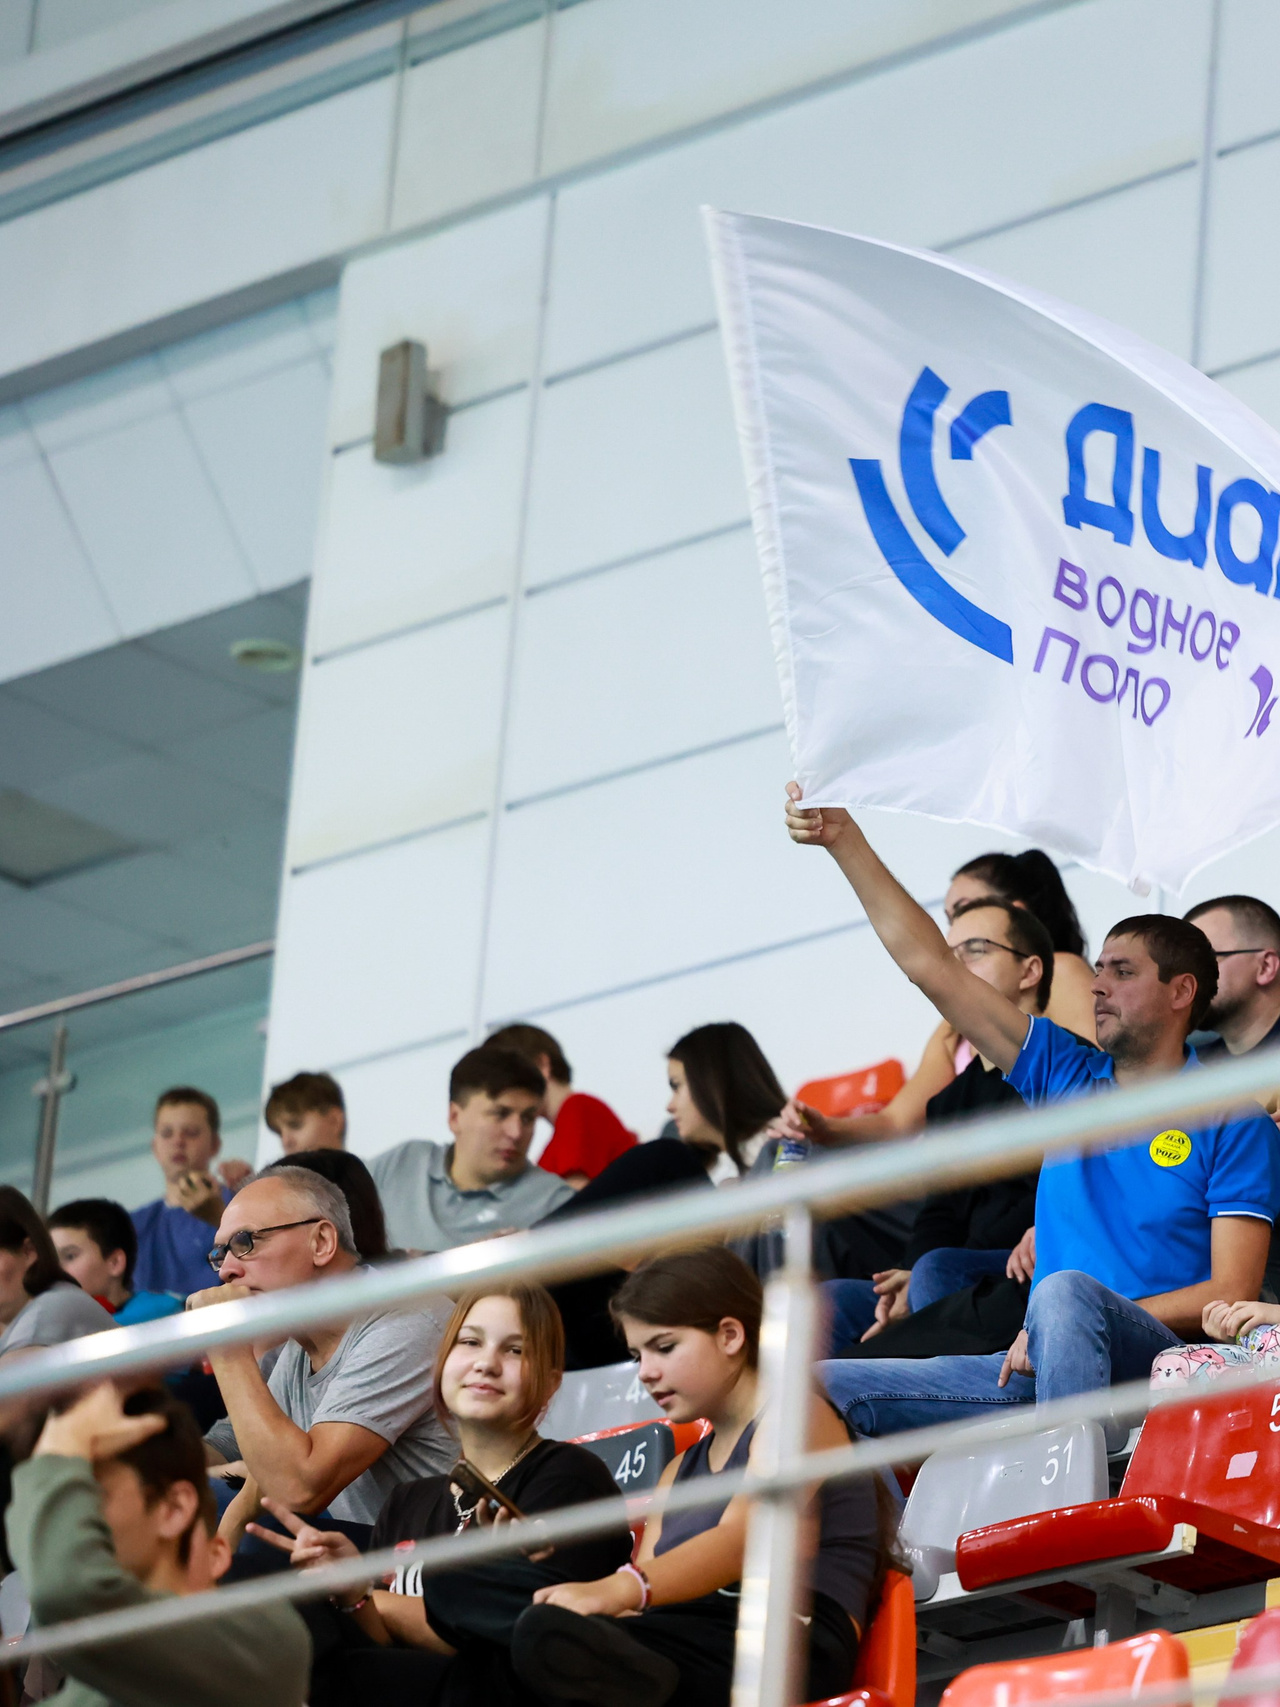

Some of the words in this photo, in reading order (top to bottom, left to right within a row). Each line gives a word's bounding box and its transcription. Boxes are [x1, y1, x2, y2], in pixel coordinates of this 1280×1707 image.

[1053, 557, 1241, 671] водное
[1033, 626, 1171, 727] поло
[1156, 1148, 1181, 1160] POLO
[615, 1441, 647, 1483] 45
[1041, 1436, 1073, 1485] 51
